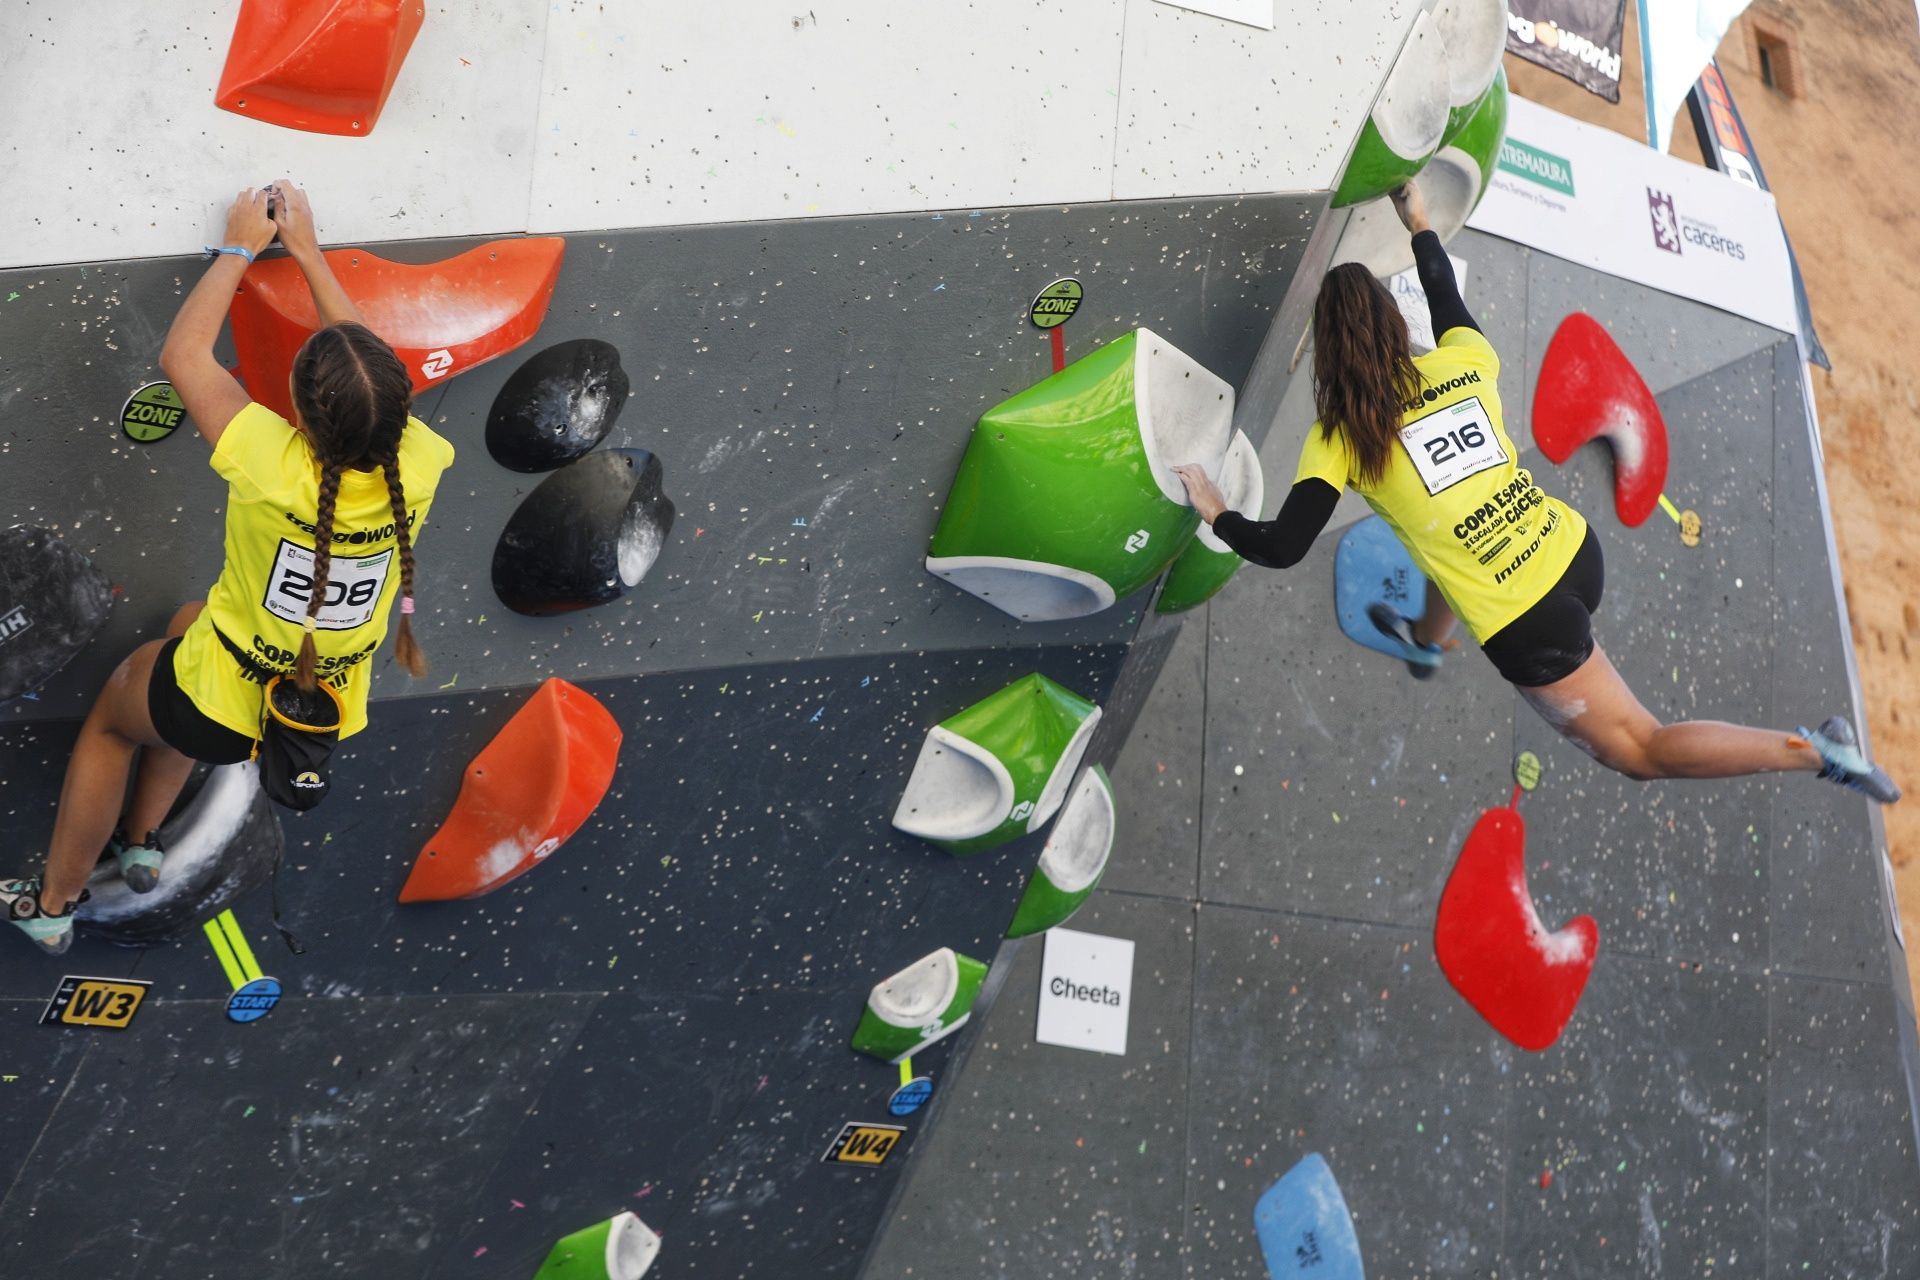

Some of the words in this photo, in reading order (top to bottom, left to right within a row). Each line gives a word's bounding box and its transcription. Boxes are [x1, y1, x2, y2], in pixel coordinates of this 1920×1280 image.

[1034, 298, 1079, 312] ZONE
[125, 402, 182, 427] ZONE
[1423, 421, 1486, 467] 216
[1453, 502, 1499, 540] COPA
[1469, 516, 1505, 547] ESCALADA
[279, 568, 377, 607] 208
[72, 989, 136, 1020] W3
[229, 996, 279, 1008] START
[1050, 976, 1121, 1007] Cheeta
[846, 1132, 894, 1158] W4
